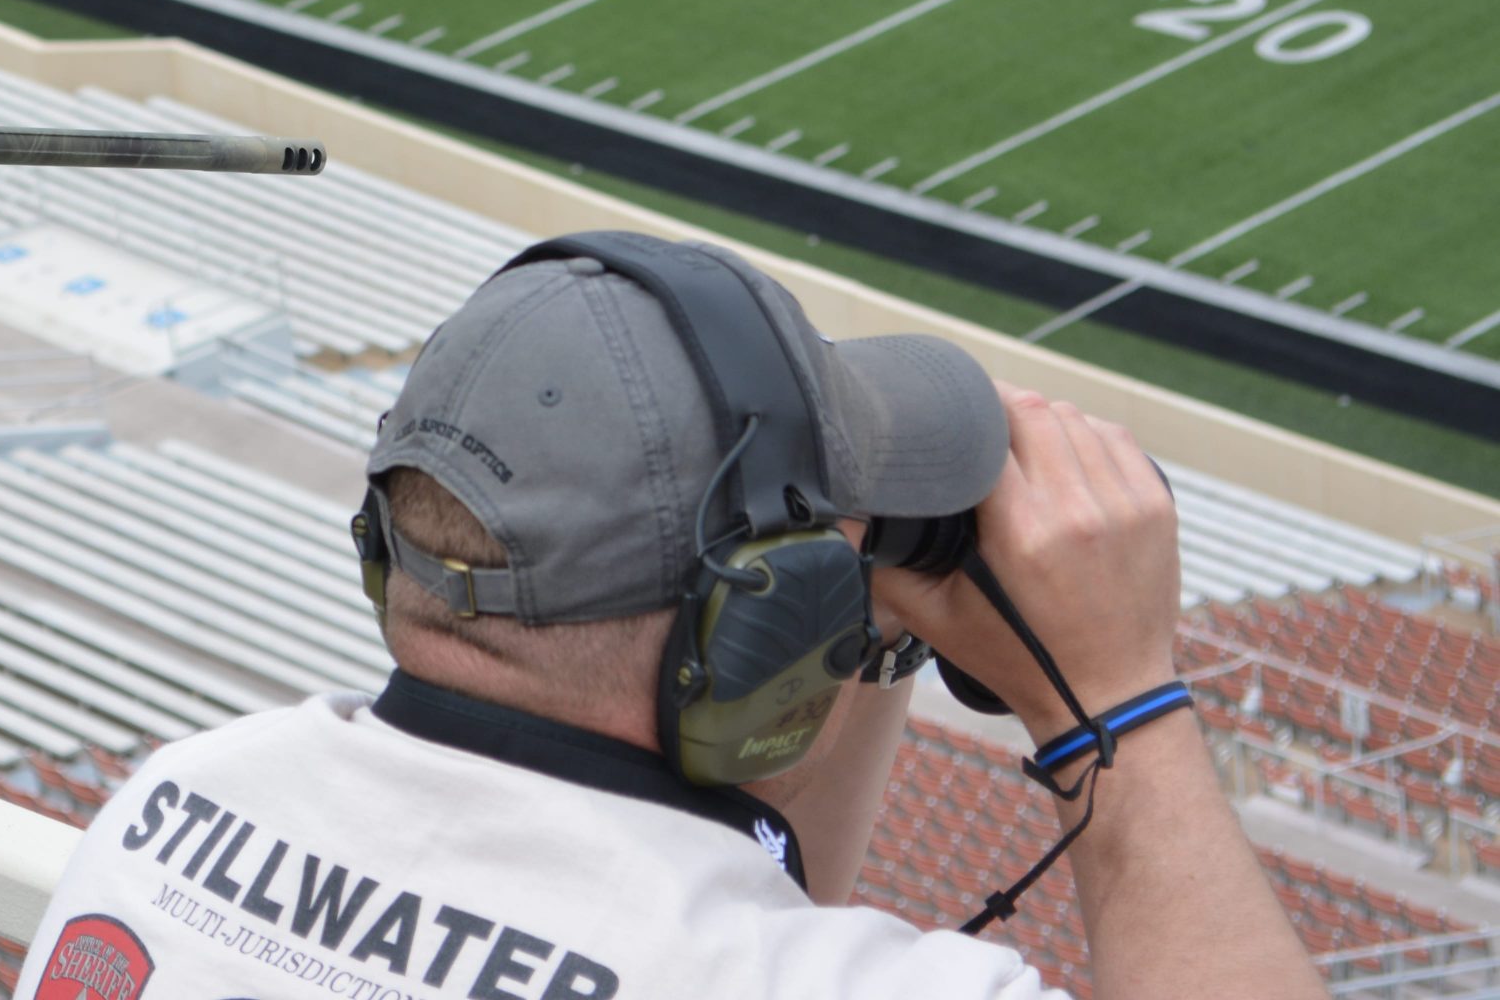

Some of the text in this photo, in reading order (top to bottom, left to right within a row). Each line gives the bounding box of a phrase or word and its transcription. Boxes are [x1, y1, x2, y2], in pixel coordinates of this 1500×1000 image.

[461, 434, 514, 484] OPTICS
[738, 727, 813, 760] IMPACT
[151, 884, 422, 1000] MULTI-JURISDICTIO
[51, 941, 136, 1000] SHERIFF
